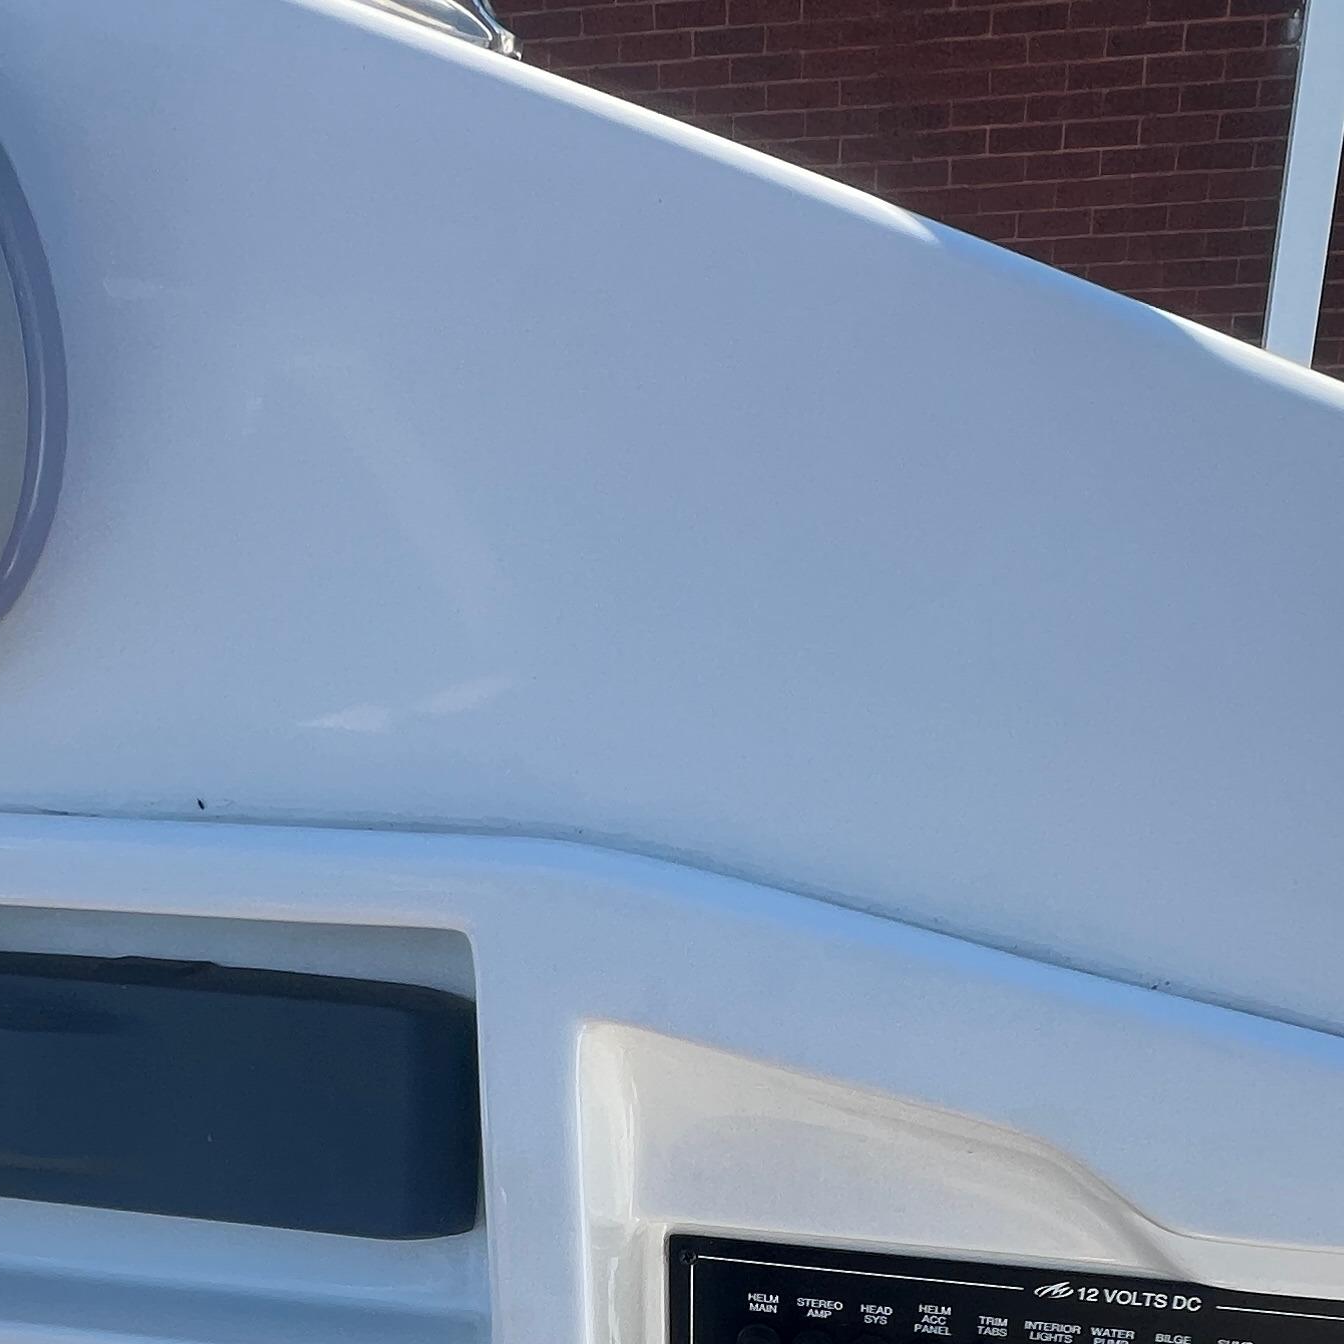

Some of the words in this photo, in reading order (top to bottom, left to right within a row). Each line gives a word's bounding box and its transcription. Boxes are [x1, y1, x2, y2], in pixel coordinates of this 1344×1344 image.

[748, 1293, 779, 1304] HELM
[797, 1297, 843, 1310] STEREO
[1078, 1288, 1098, 1301] 12
[1104, 1289, 1168, 1308] VOLTS
[1172, 1297, 1202, 1311] DC
[750, 1302, 777, 1313] MAIN
[860, 1304, 892, 1316] HEAD
[918, 1304, 951, 1315] HELM
[807, 1308, 832, 1319] AMP
[864, 1315, 888, 1325] SYS
[921, 1315, 947, 1325] ACC
[978, 1316, 1007, 1327] TRIM
[914, 1324, 951, 1336] PANEL
[977, 1326, 1007, 1337] TABS
[1024, 1320, 1081, 1334] INTERIOR
[1030, 1331, 1073, 1344] LIGHTS
[1091, 1327, 1135, 1340] WATER
[1155, 1334, 1192, 1344] BILGE
